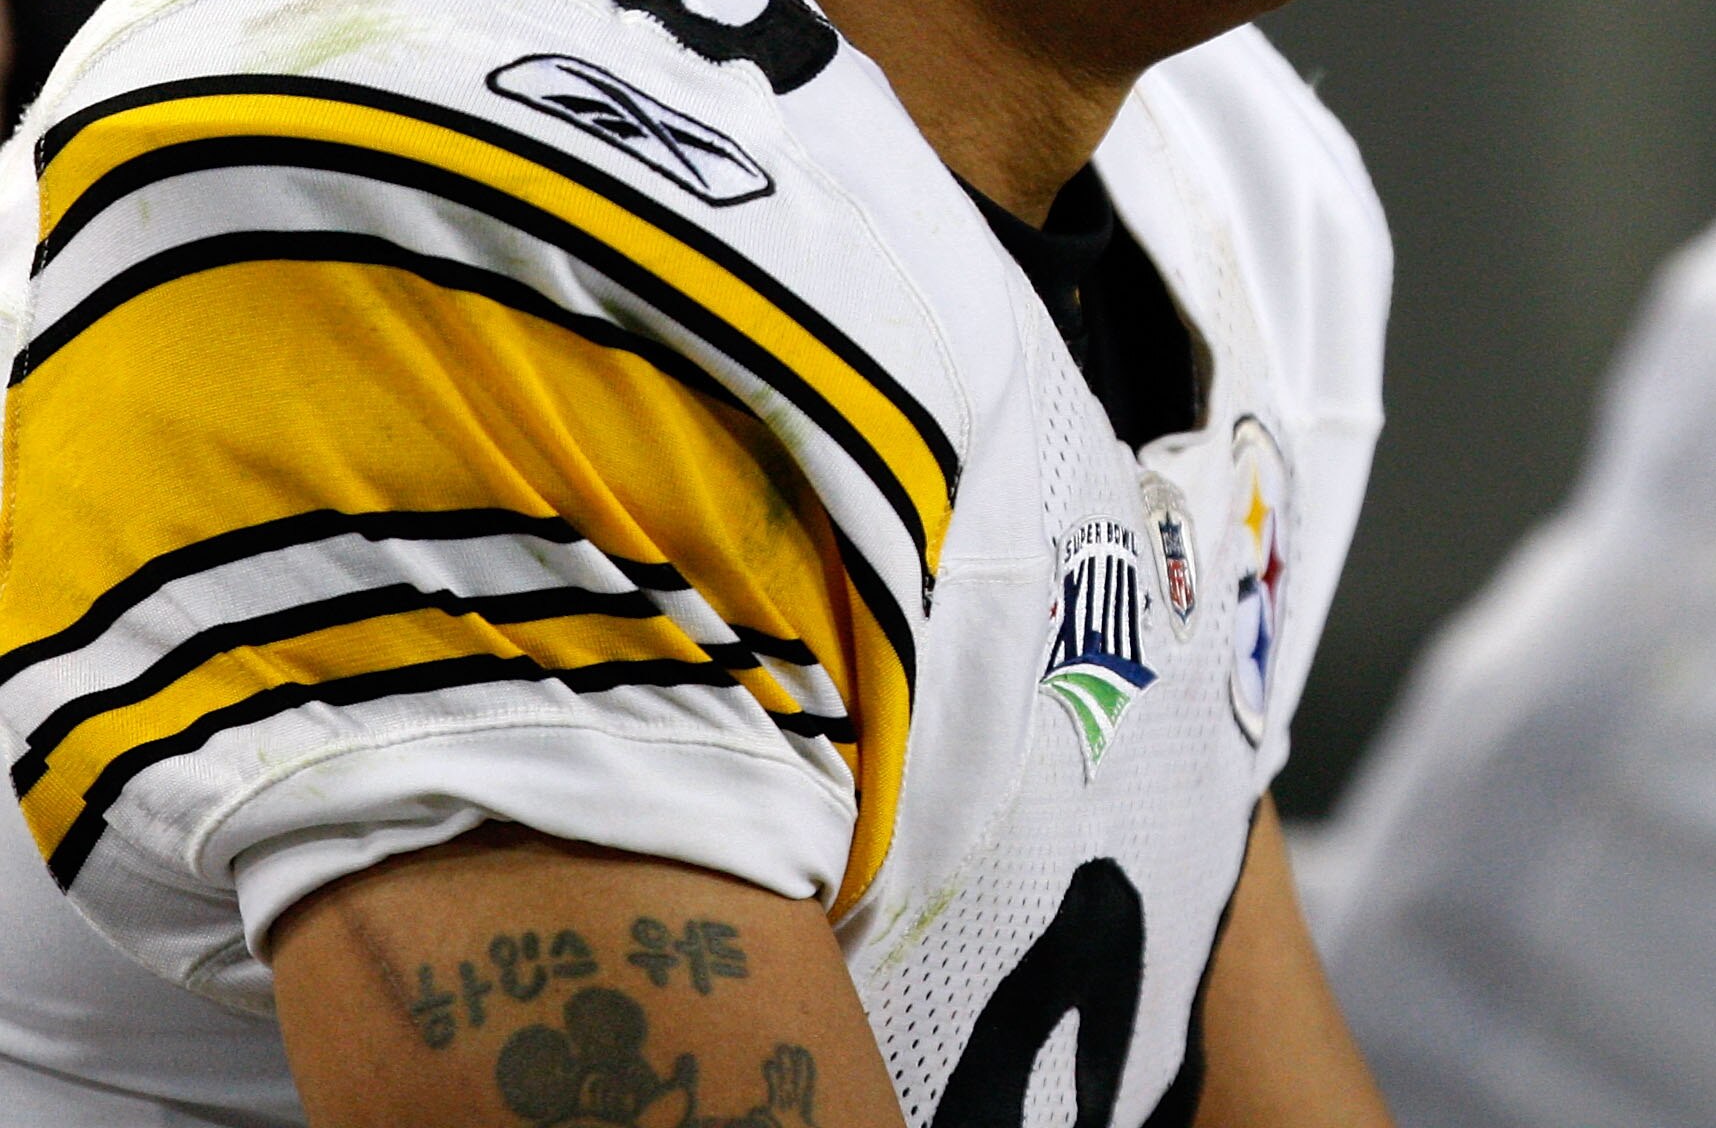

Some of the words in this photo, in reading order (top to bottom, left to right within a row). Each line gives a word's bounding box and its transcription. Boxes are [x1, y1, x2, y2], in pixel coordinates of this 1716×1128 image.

[1064, 522, 1101, 563] SUPER
[1107, 521, 1138, 557] BOWL
[411, 928, 598, 1050] 하인스
[626, 916, 749, 996] 워드
